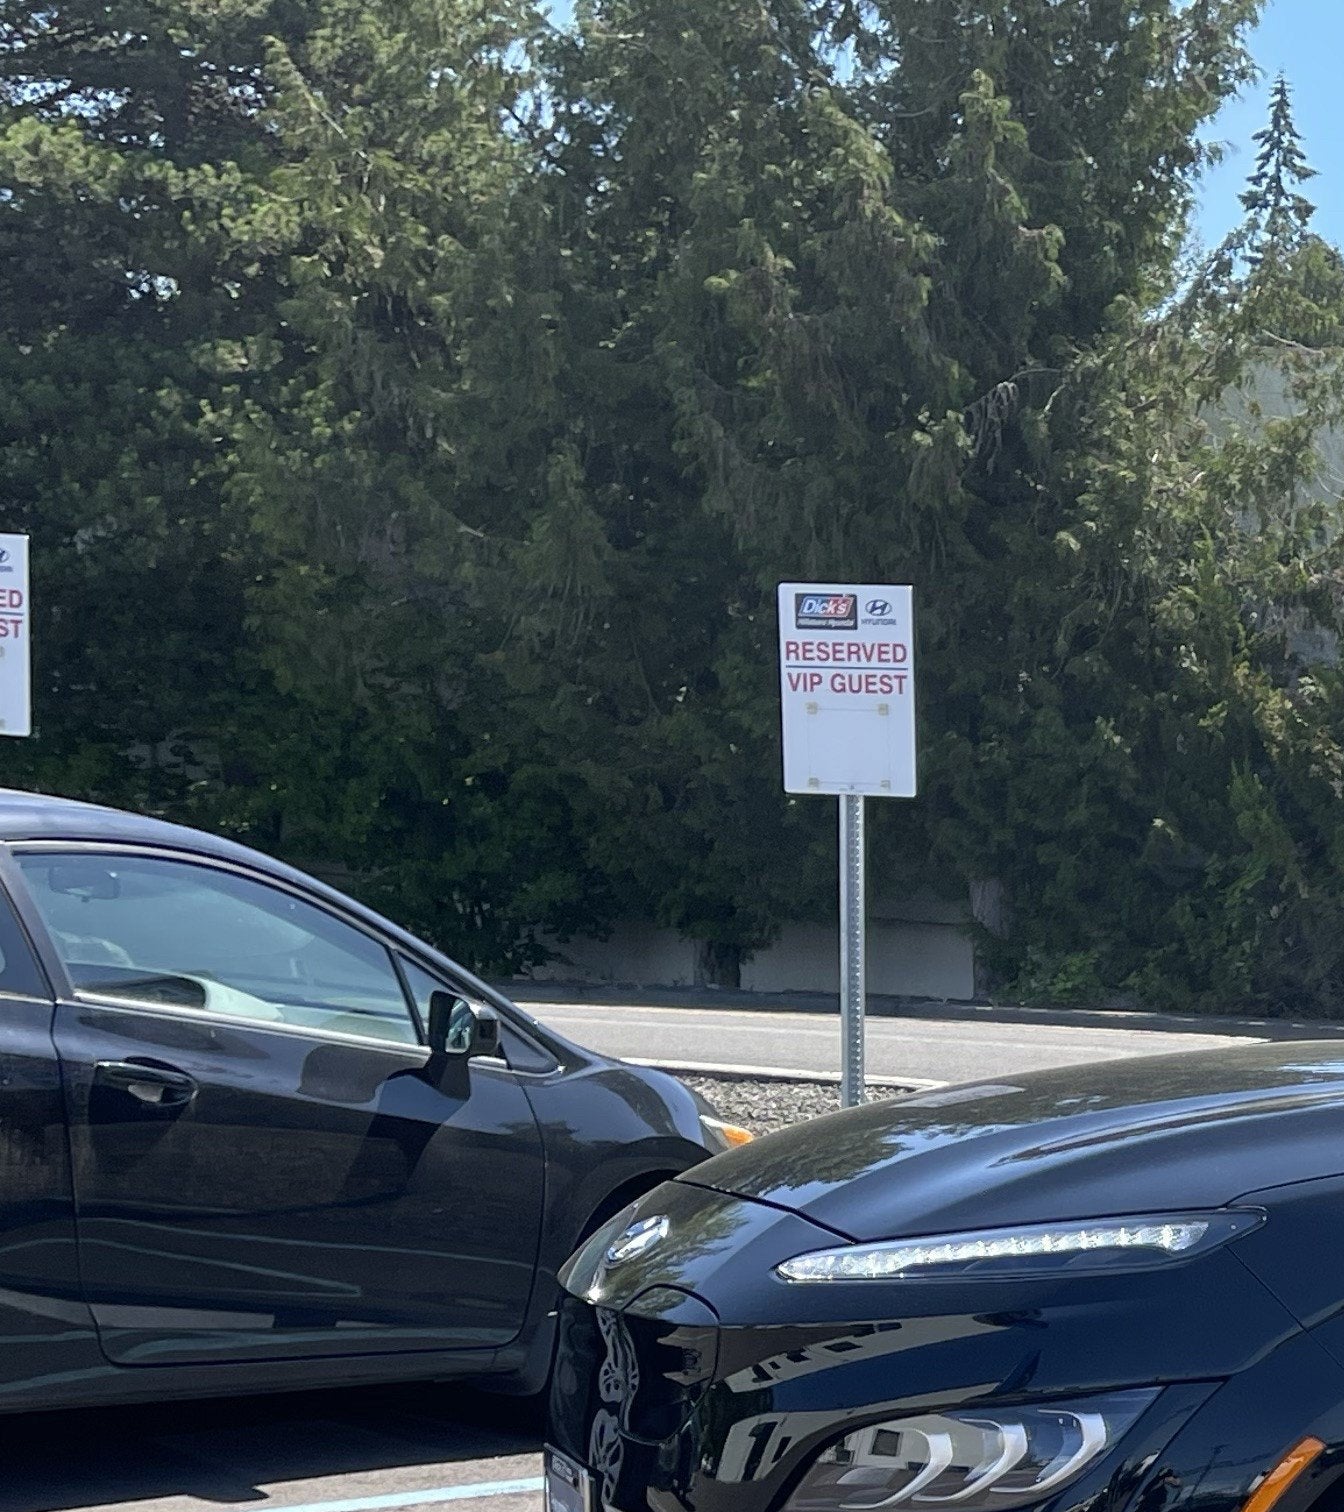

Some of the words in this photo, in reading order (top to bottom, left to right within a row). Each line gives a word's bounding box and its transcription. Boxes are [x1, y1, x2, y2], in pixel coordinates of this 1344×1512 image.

[785, 641, 908, 663] RESERVED
[787, 672, 823, 692] VIP
[830, 673, 907, 694] GUEST
